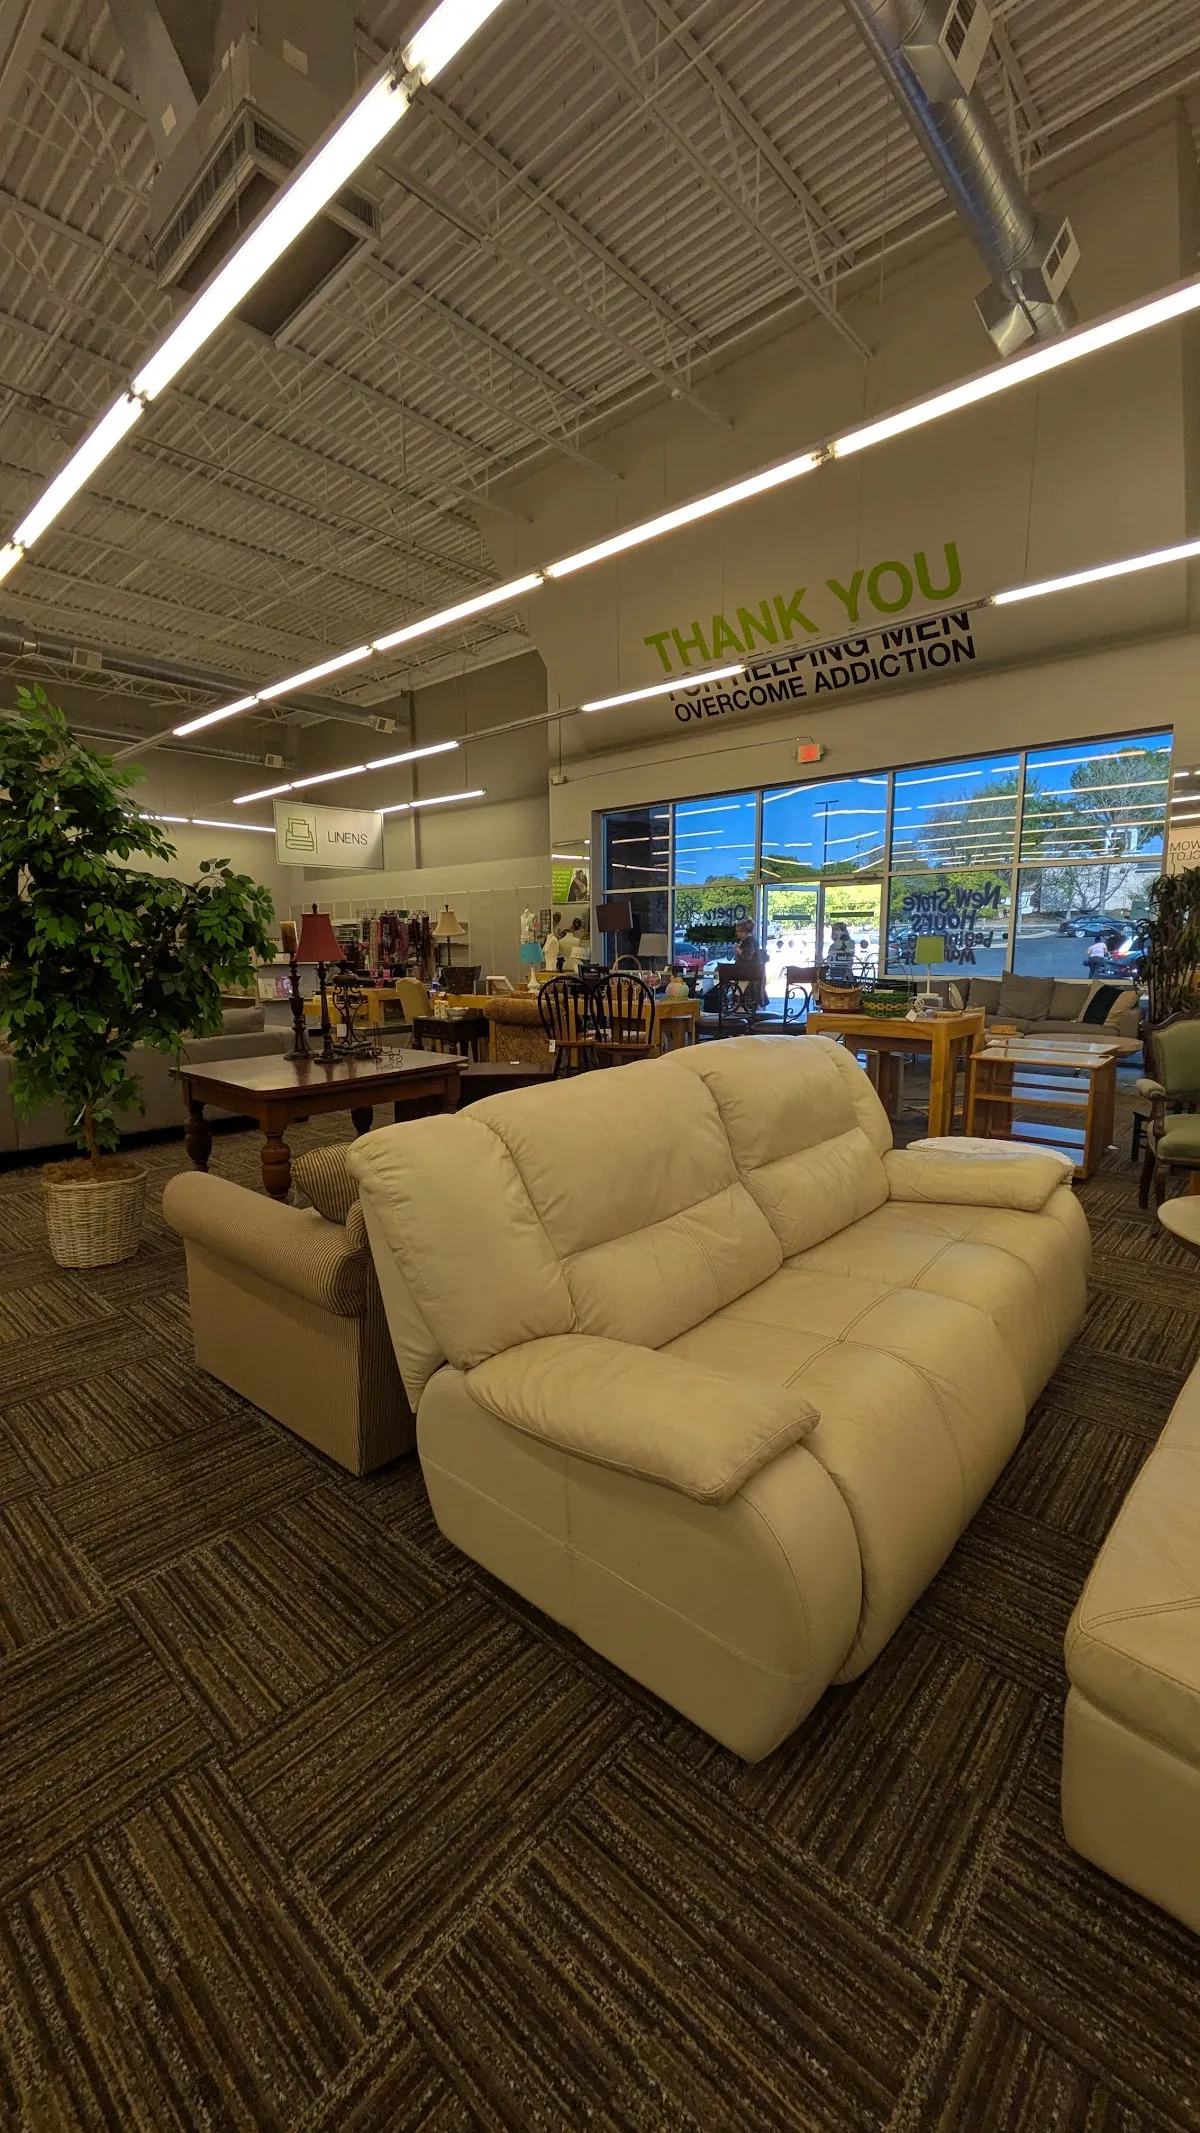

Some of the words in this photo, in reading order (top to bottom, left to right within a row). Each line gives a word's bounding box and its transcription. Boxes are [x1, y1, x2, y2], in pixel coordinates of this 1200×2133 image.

[644, 588, 820, 673] THANK
[825, 541, 962, 622] YOU
[881, 611, 971, 650] MEN
[675, 676, 807, 722] OVERCOME
[815, 636, 976, 693] ADDICTION
[327, 831, 368, 845] LINENS
